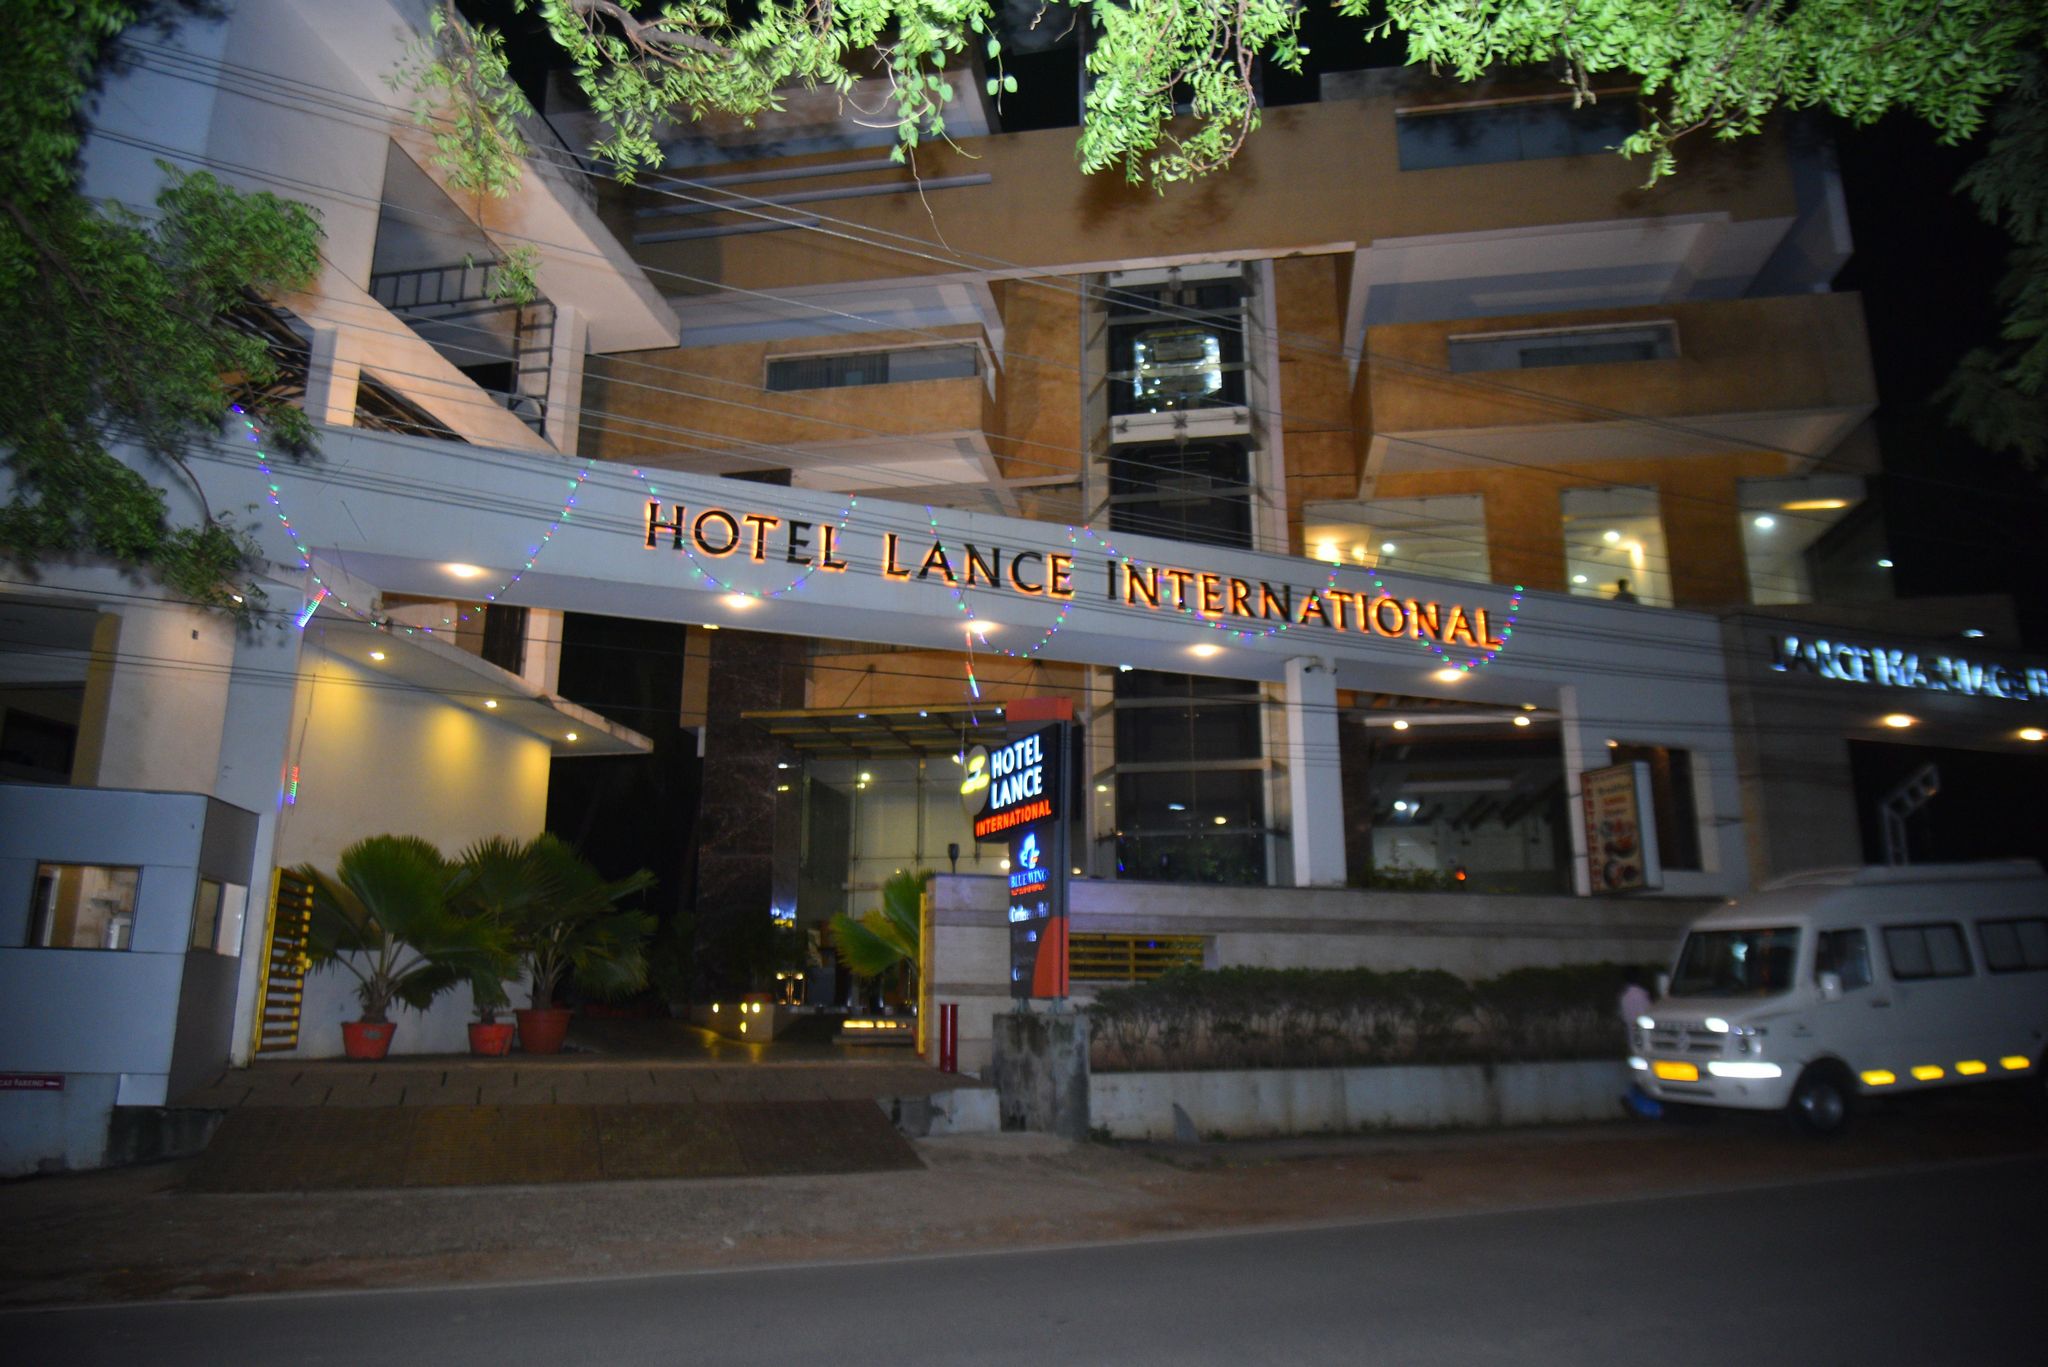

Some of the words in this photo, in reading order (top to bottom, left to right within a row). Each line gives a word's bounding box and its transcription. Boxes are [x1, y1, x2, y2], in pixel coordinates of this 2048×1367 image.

[645, 499, 848, 571] HOTEL
[884, 533, 1076, 599] LANCE
[1108, 561, 1502, 649] INTERNATIONAL
[991, 734, 1043, 777] HOTEL
[991, 767, 1042, 810] LANCE
[976, 800, 1052, 837] INTERNATIONAL
[1010, 873, 1027, 888] BLUE
